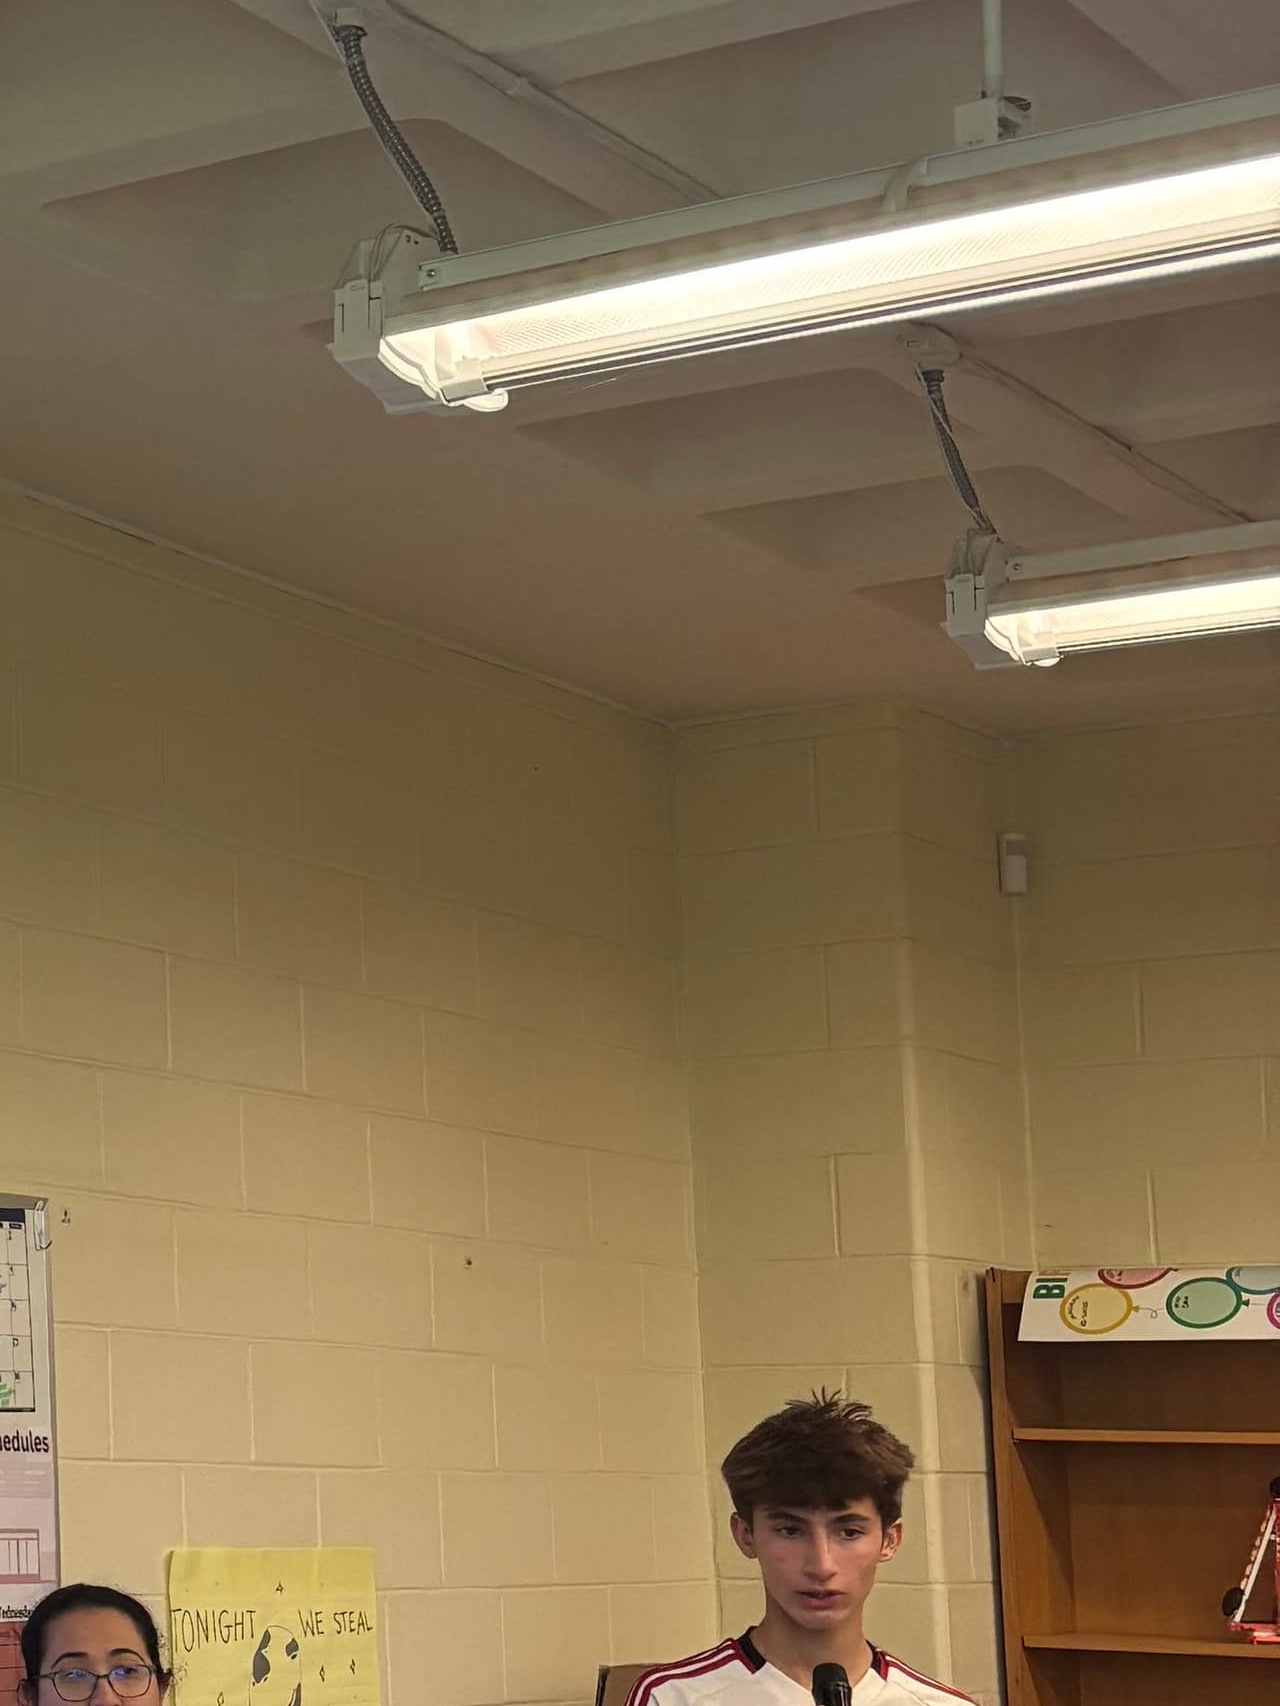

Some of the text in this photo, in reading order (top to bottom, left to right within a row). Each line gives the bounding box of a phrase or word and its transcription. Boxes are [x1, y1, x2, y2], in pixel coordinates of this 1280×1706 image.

[170, 1608, 373, 1654] TONIGHT WE STEAL
